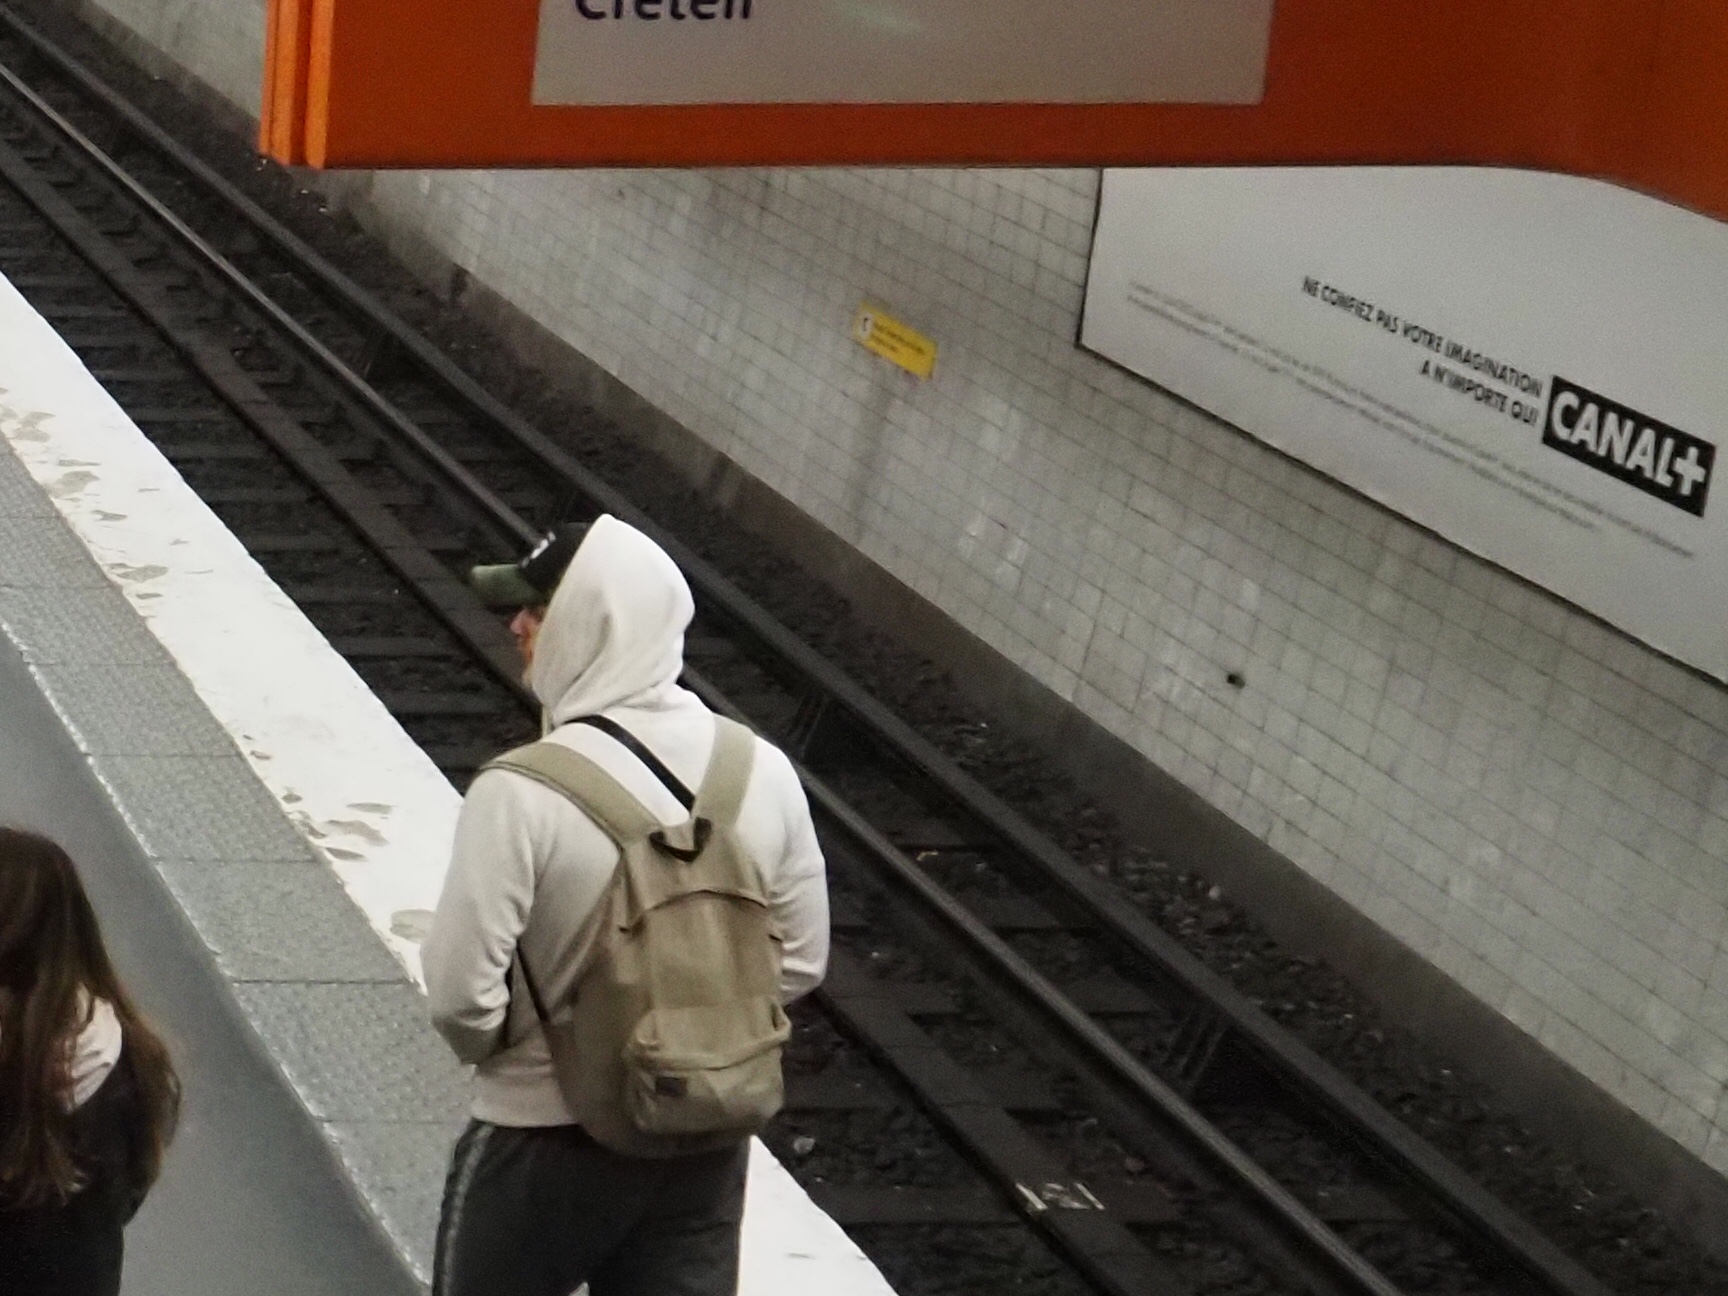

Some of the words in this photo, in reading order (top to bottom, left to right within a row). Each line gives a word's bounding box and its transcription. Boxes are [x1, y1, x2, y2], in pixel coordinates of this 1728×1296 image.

[1376, 308, 1399, 334] PAS
[1402, 320, 1443, 354] VOTRE
[1510, 400, 1539, 427] QUI
[1550, 389, 1707, 497] CANAL+
